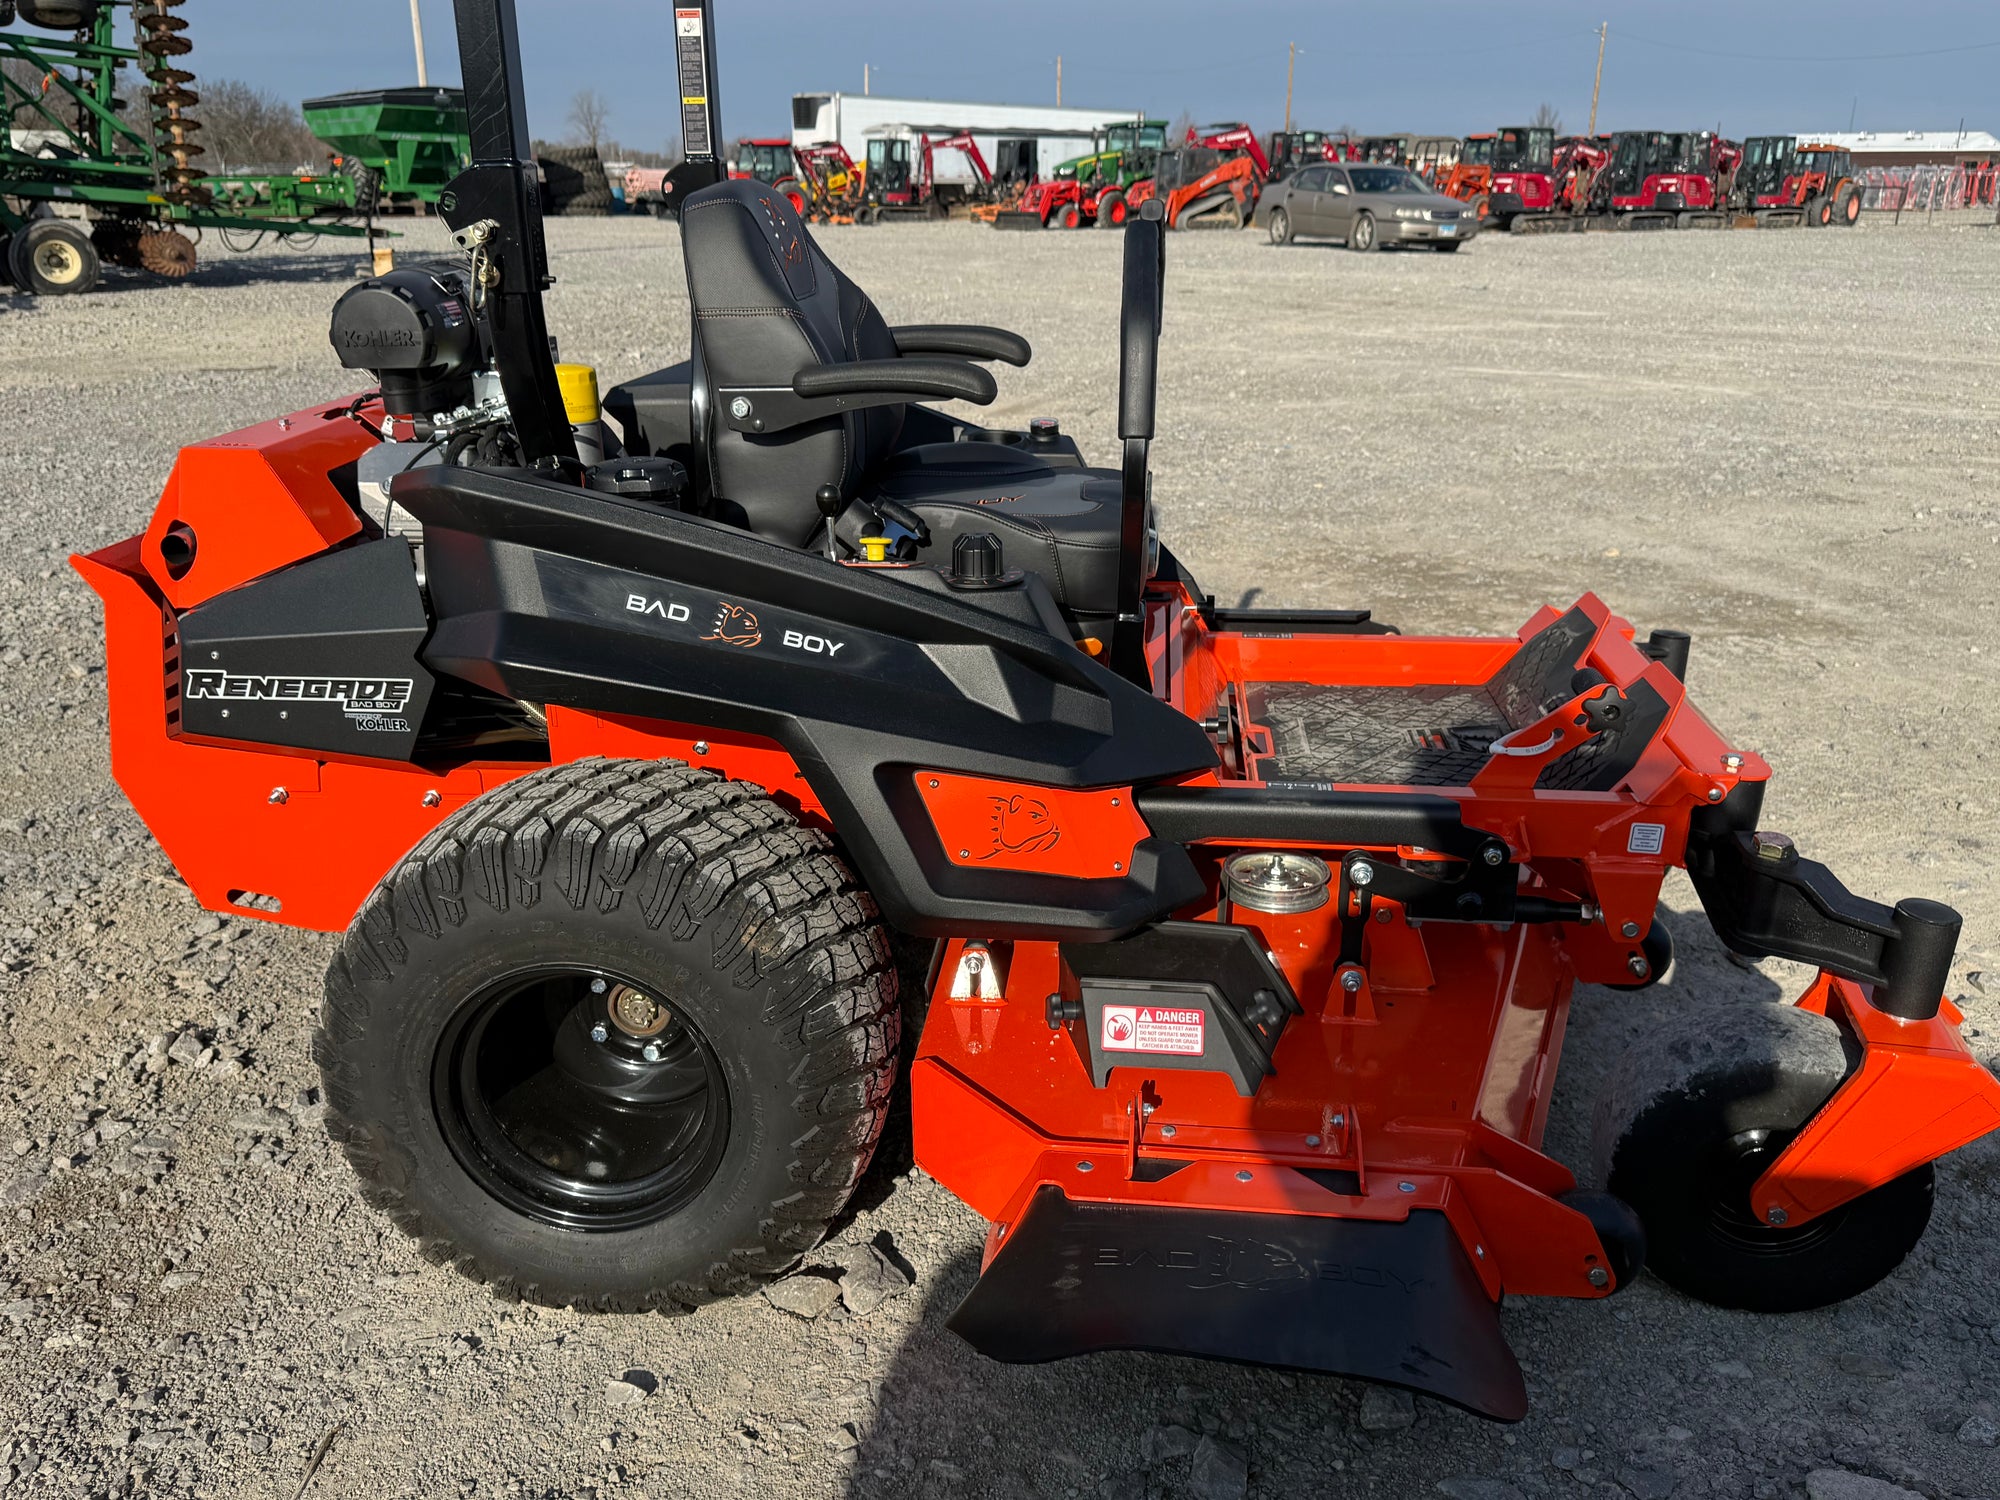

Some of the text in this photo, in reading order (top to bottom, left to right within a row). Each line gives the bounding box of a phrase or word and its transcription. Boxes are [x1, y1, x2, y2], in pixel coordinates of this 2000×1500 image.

[344, 330, 416, 348] KOHLER
[626, 594, 844, 657] BAD BOY
[187, 670, 413, 702] RENEGADE
[356, 718, 411, 731] KOHLER
[1156, 1011, 1200, 1023] DANGER
[1094, 1248, 1424, 1294] BAD BOY
